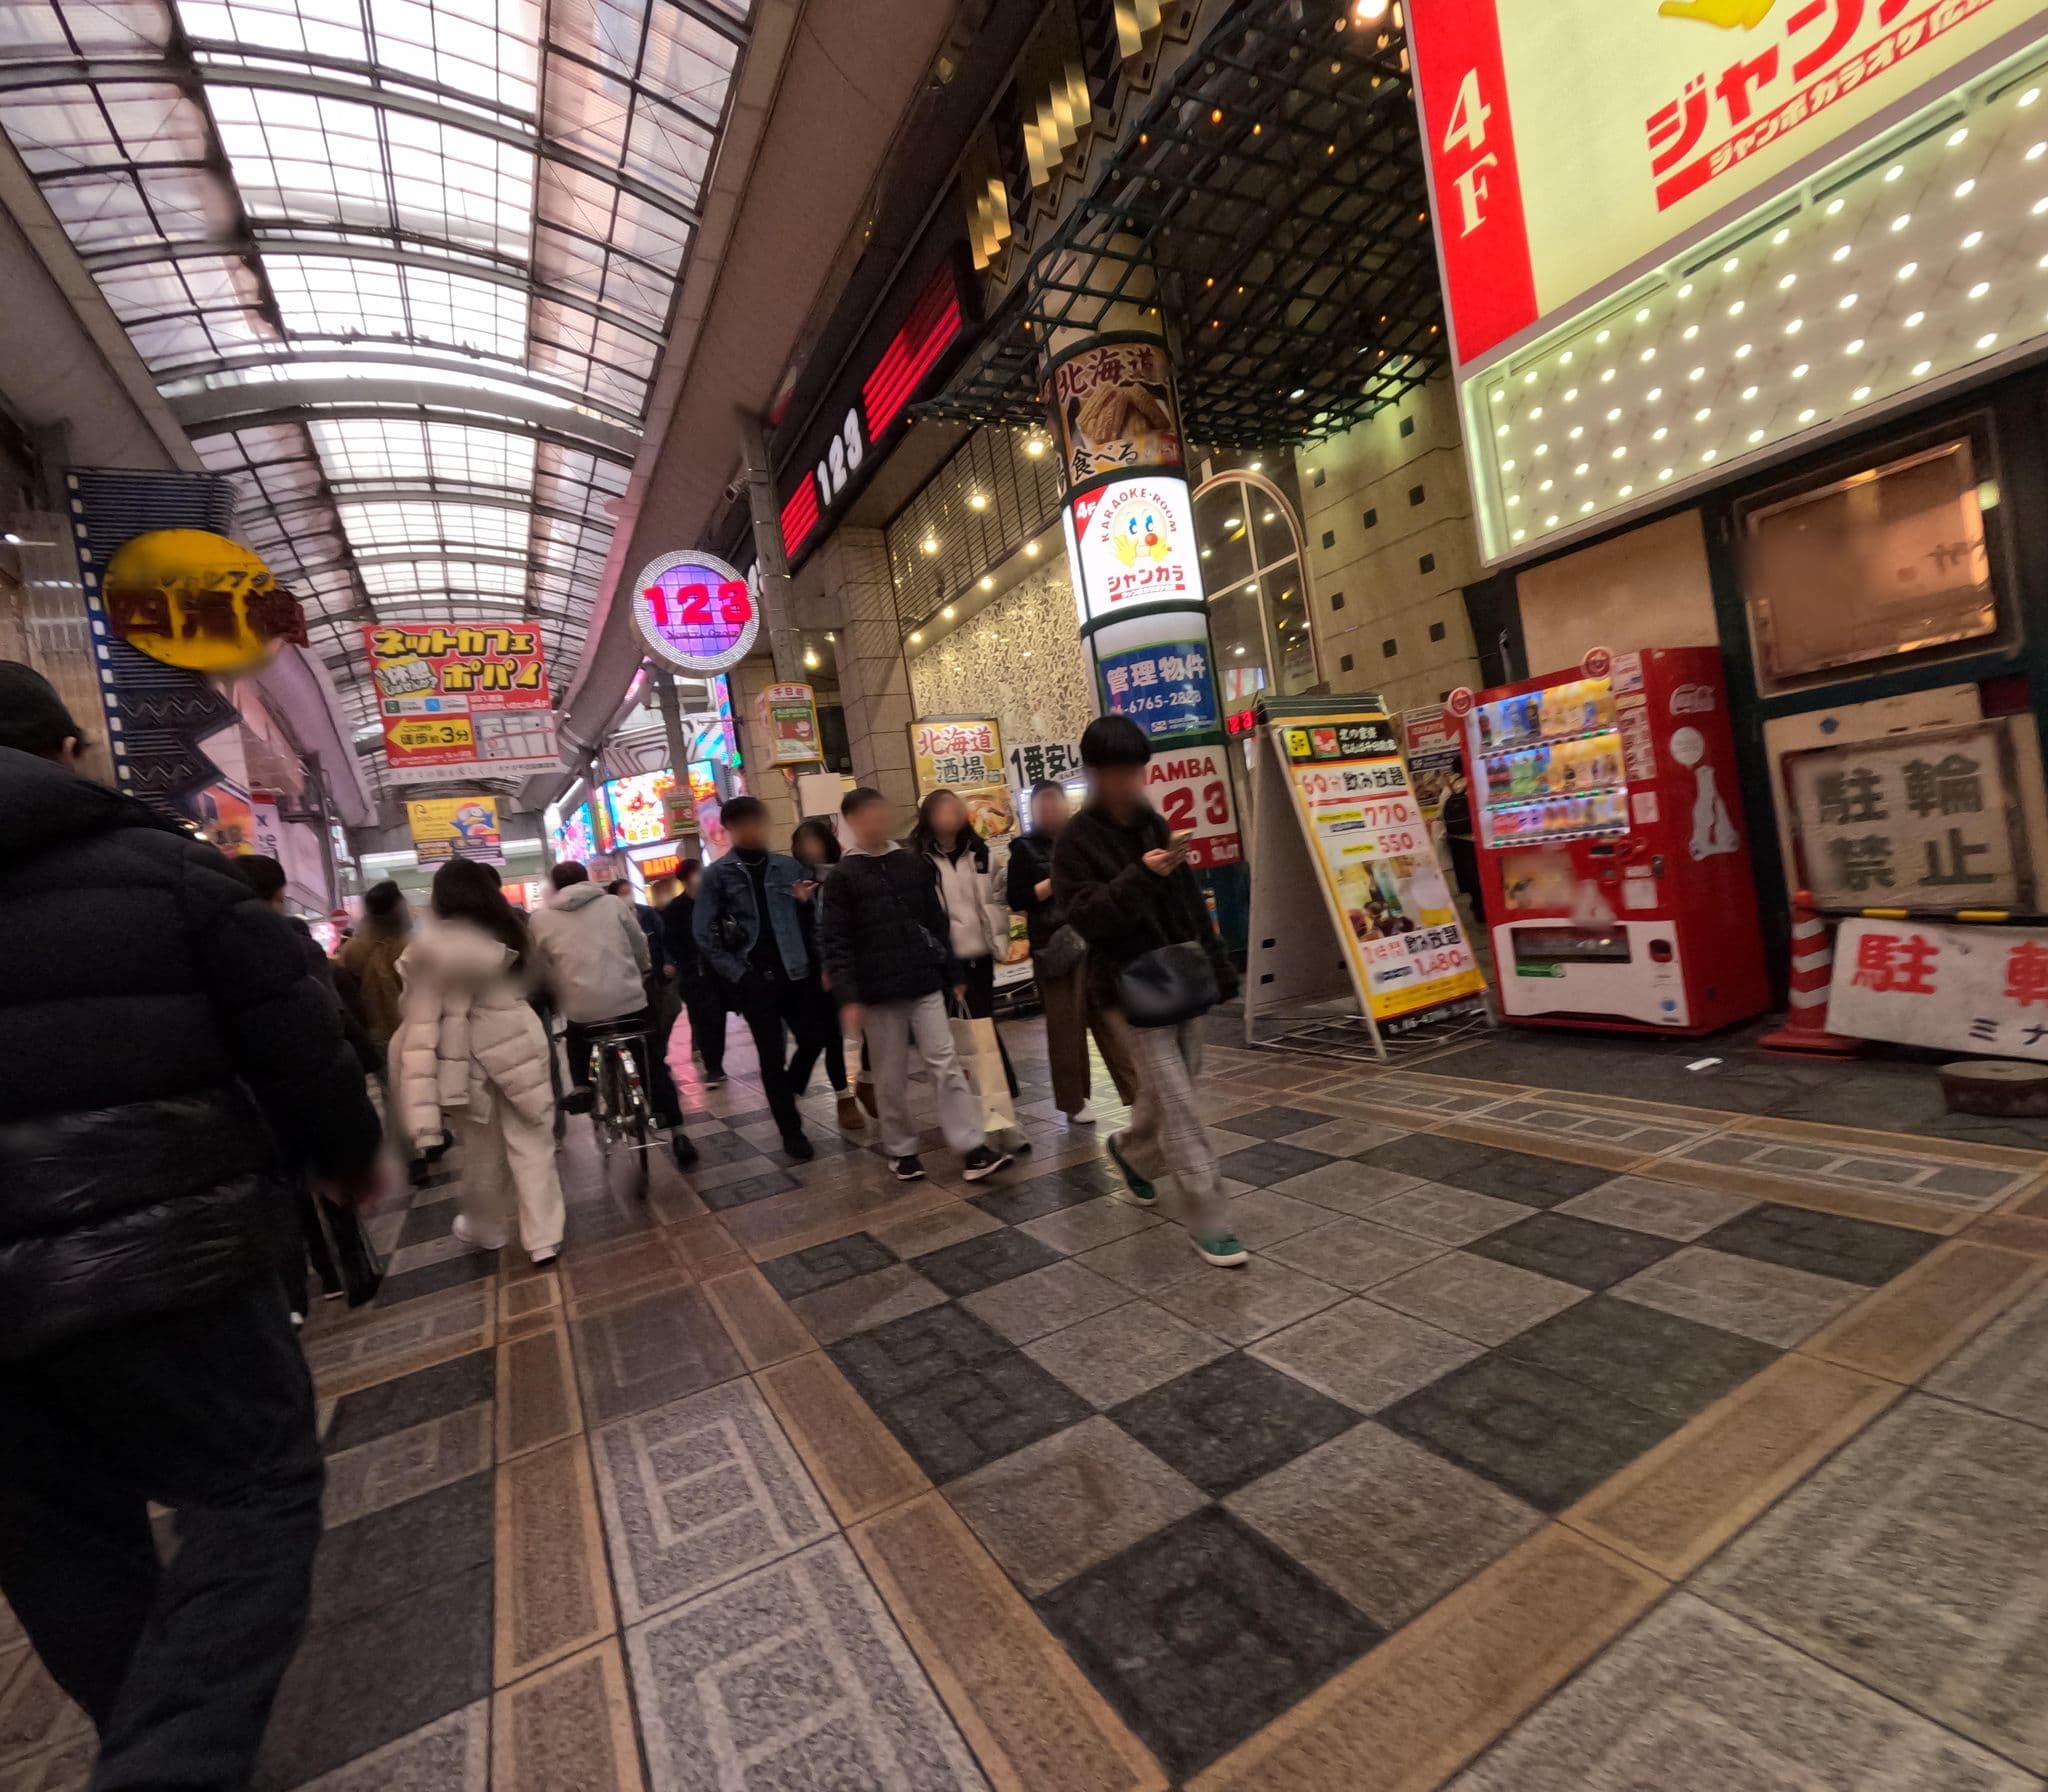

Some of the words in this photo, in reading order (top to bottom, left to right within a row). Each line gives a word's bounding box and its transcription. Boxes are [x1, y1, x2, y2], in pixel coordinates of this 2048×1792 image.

[817, 407, 863, 506] 123
[642, 579, 753, 626] 123
[372, 627, 536, 660] ネットカフェ
[441, 657, 542, 693] ポパイ
[1106, 653, 1206, 695] 管理物件
[918, 726, 996, 757] 北海道
[935, 755, 985, 784] 酒場
[1144, 756, 1218, 786] AMBA
